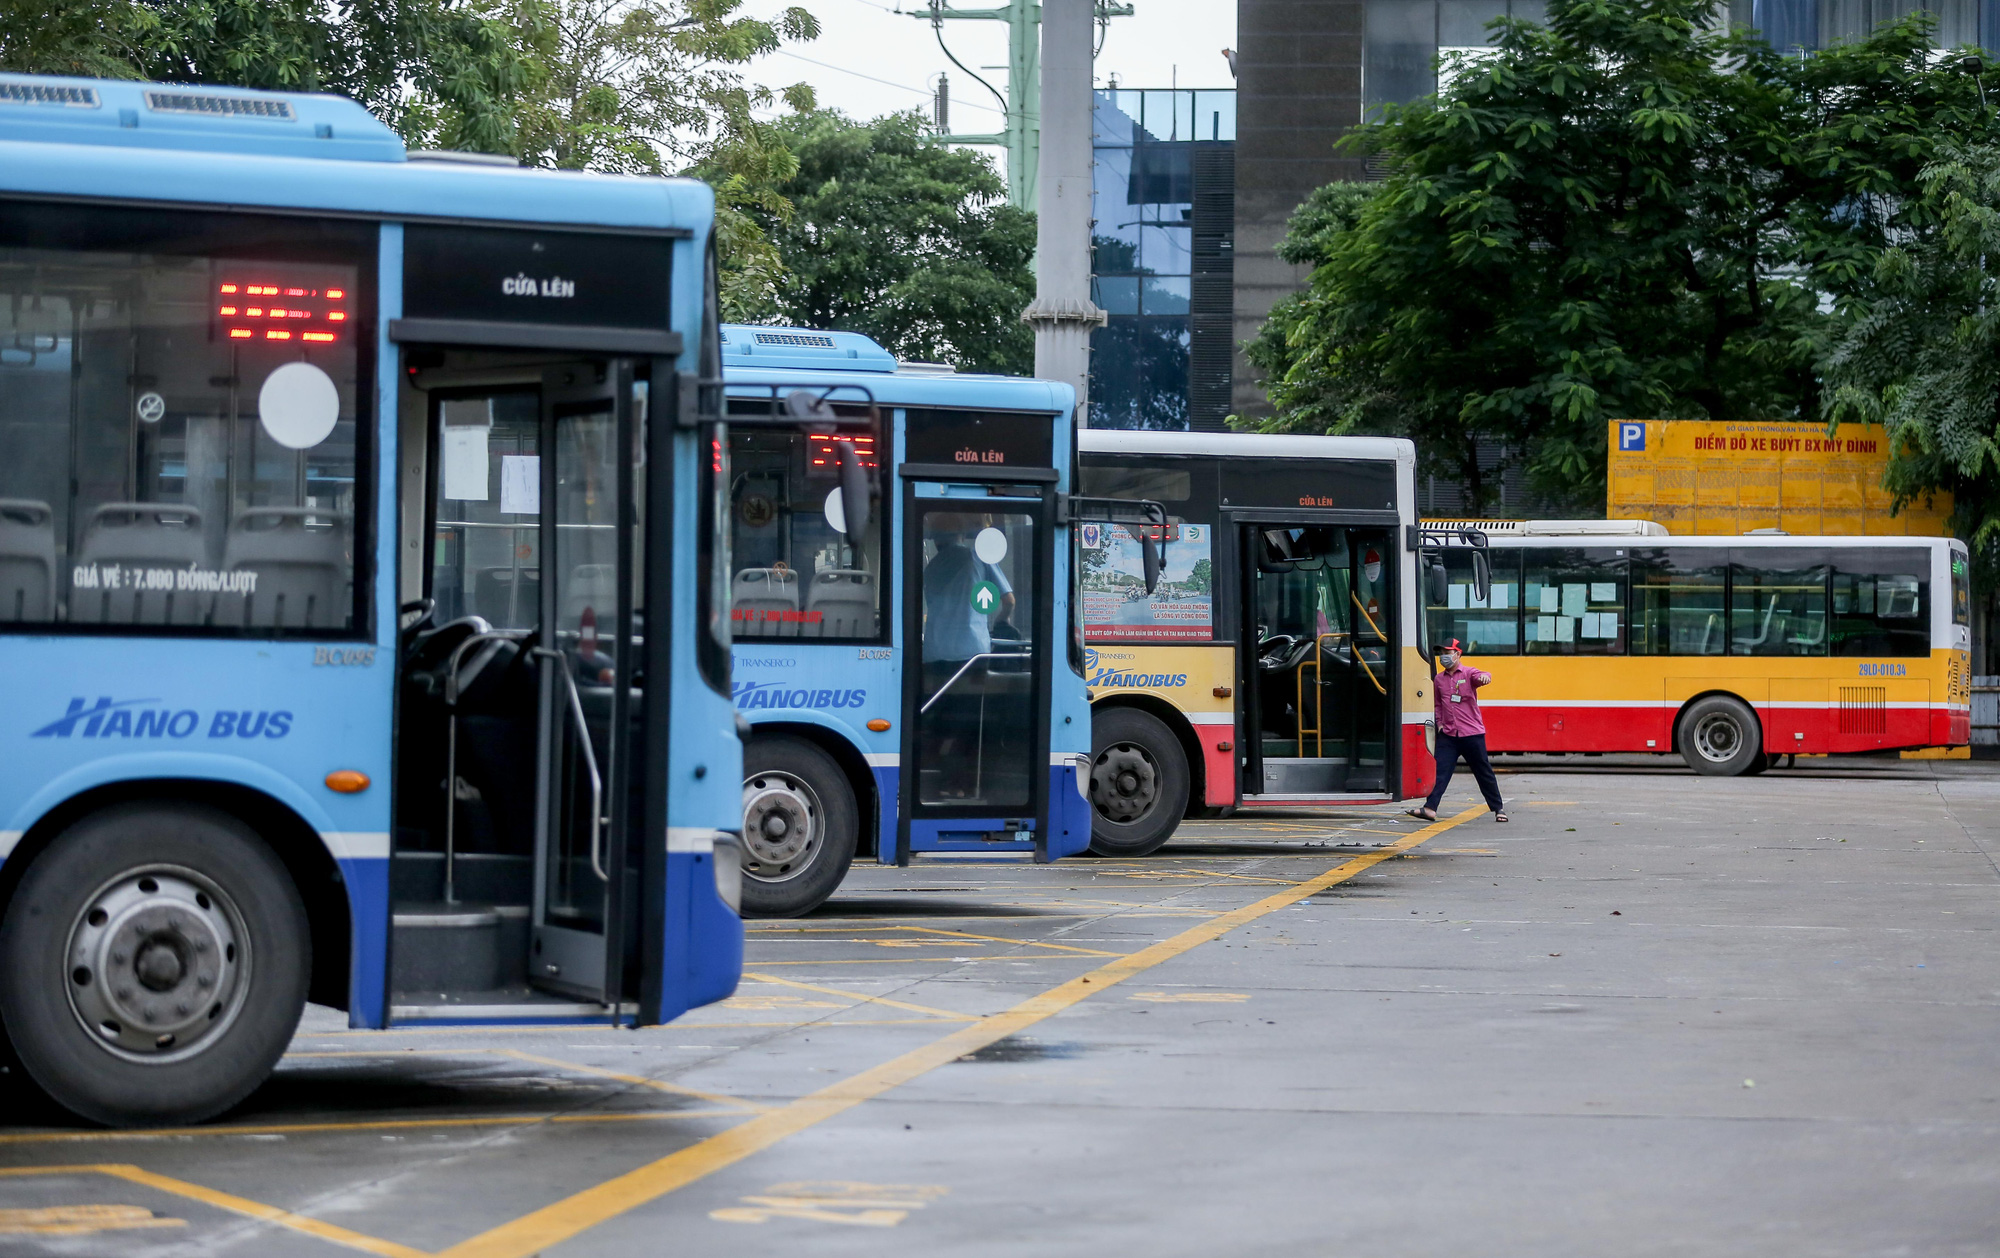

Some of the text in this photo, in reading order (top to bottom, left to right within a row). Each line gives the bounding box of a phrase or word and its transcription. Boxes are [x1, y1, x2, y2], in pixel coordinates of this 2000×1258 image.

[502, 271, 575, 298] CỬA LÊN
[1623, 425, 1641, 447] P
[1756, 425, 1780, 433] THÔNG
[1694, 432, 1877, 453] ĐIỂM ĐỖ XE BUÝT BX MỸ ĐÌNH
[955, 446, 1004, 463] CỬA LÊN
[1299, 494, 1333, 506] CỬA LÊN
[73, 562, 99, 588] GIÁ
[102, 563, 121, 588] VÉ
[133, 568, 174, 590] 7.000
[731, 608, 743, 620] GIÁ
[745, 608, 754, 620] VÉ
[760, 610, 780, 621] 7.000
[313, 645, 377, 667] BC095
[741, 658, 796, 667] TRANSERCO
[858, 648, 892, 660] BC095
[1086, 668, 1187, 687] HANOIBUS
[1858, 664, 1906, 676] 29LD-010.34
[731, 682, 866, 708] HANOIBUS
[29, 697, 293, 739] HANO BUS
